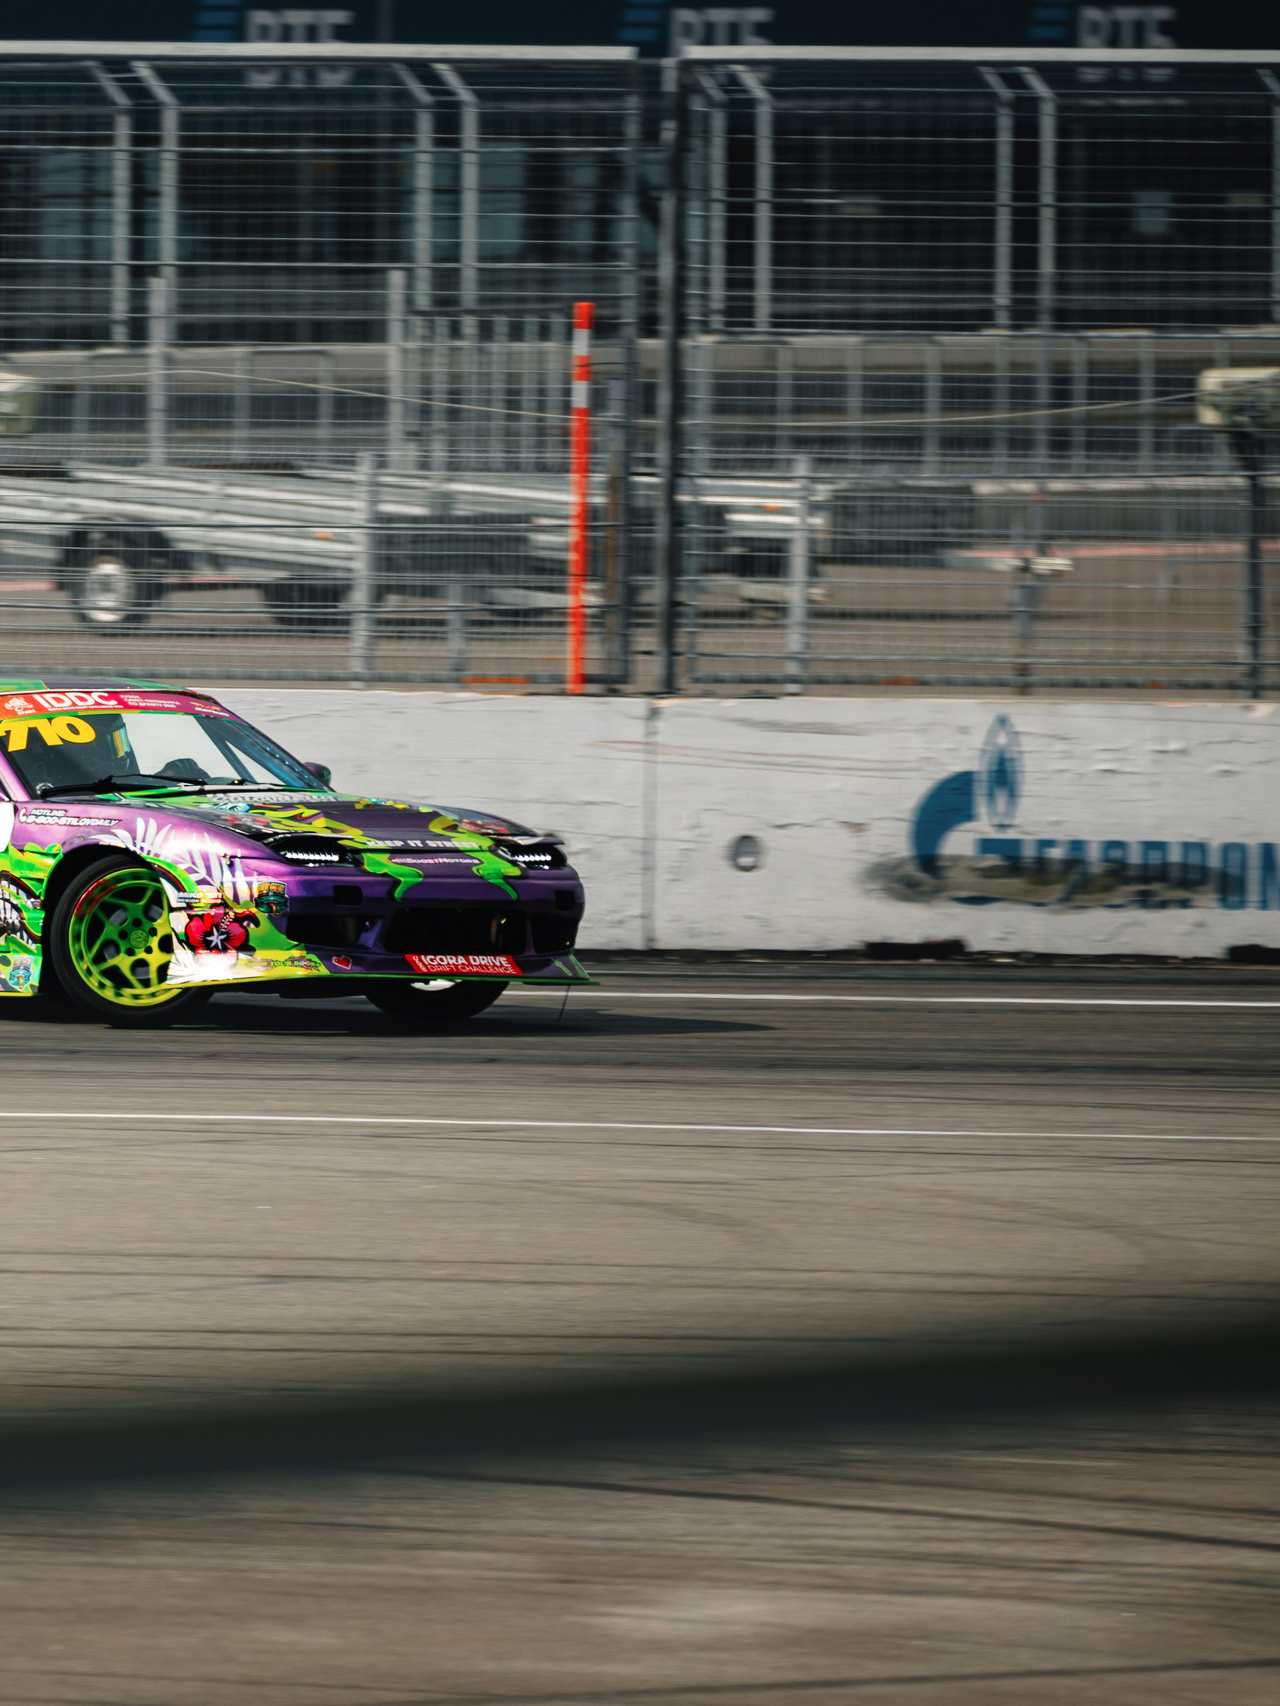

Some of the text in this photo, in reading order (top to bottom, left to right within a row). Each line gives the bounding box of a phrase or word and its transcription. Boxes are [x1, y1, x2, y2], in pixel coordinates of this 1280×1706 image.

[32, 692, 118, 710] IDDC
[426, 840, 479, 849] STREET
[421, 955, 468, 965] IGORA
[468, 955, 511, 967] DRIVE
[458, 965, 517, 974] CHALLENGE
